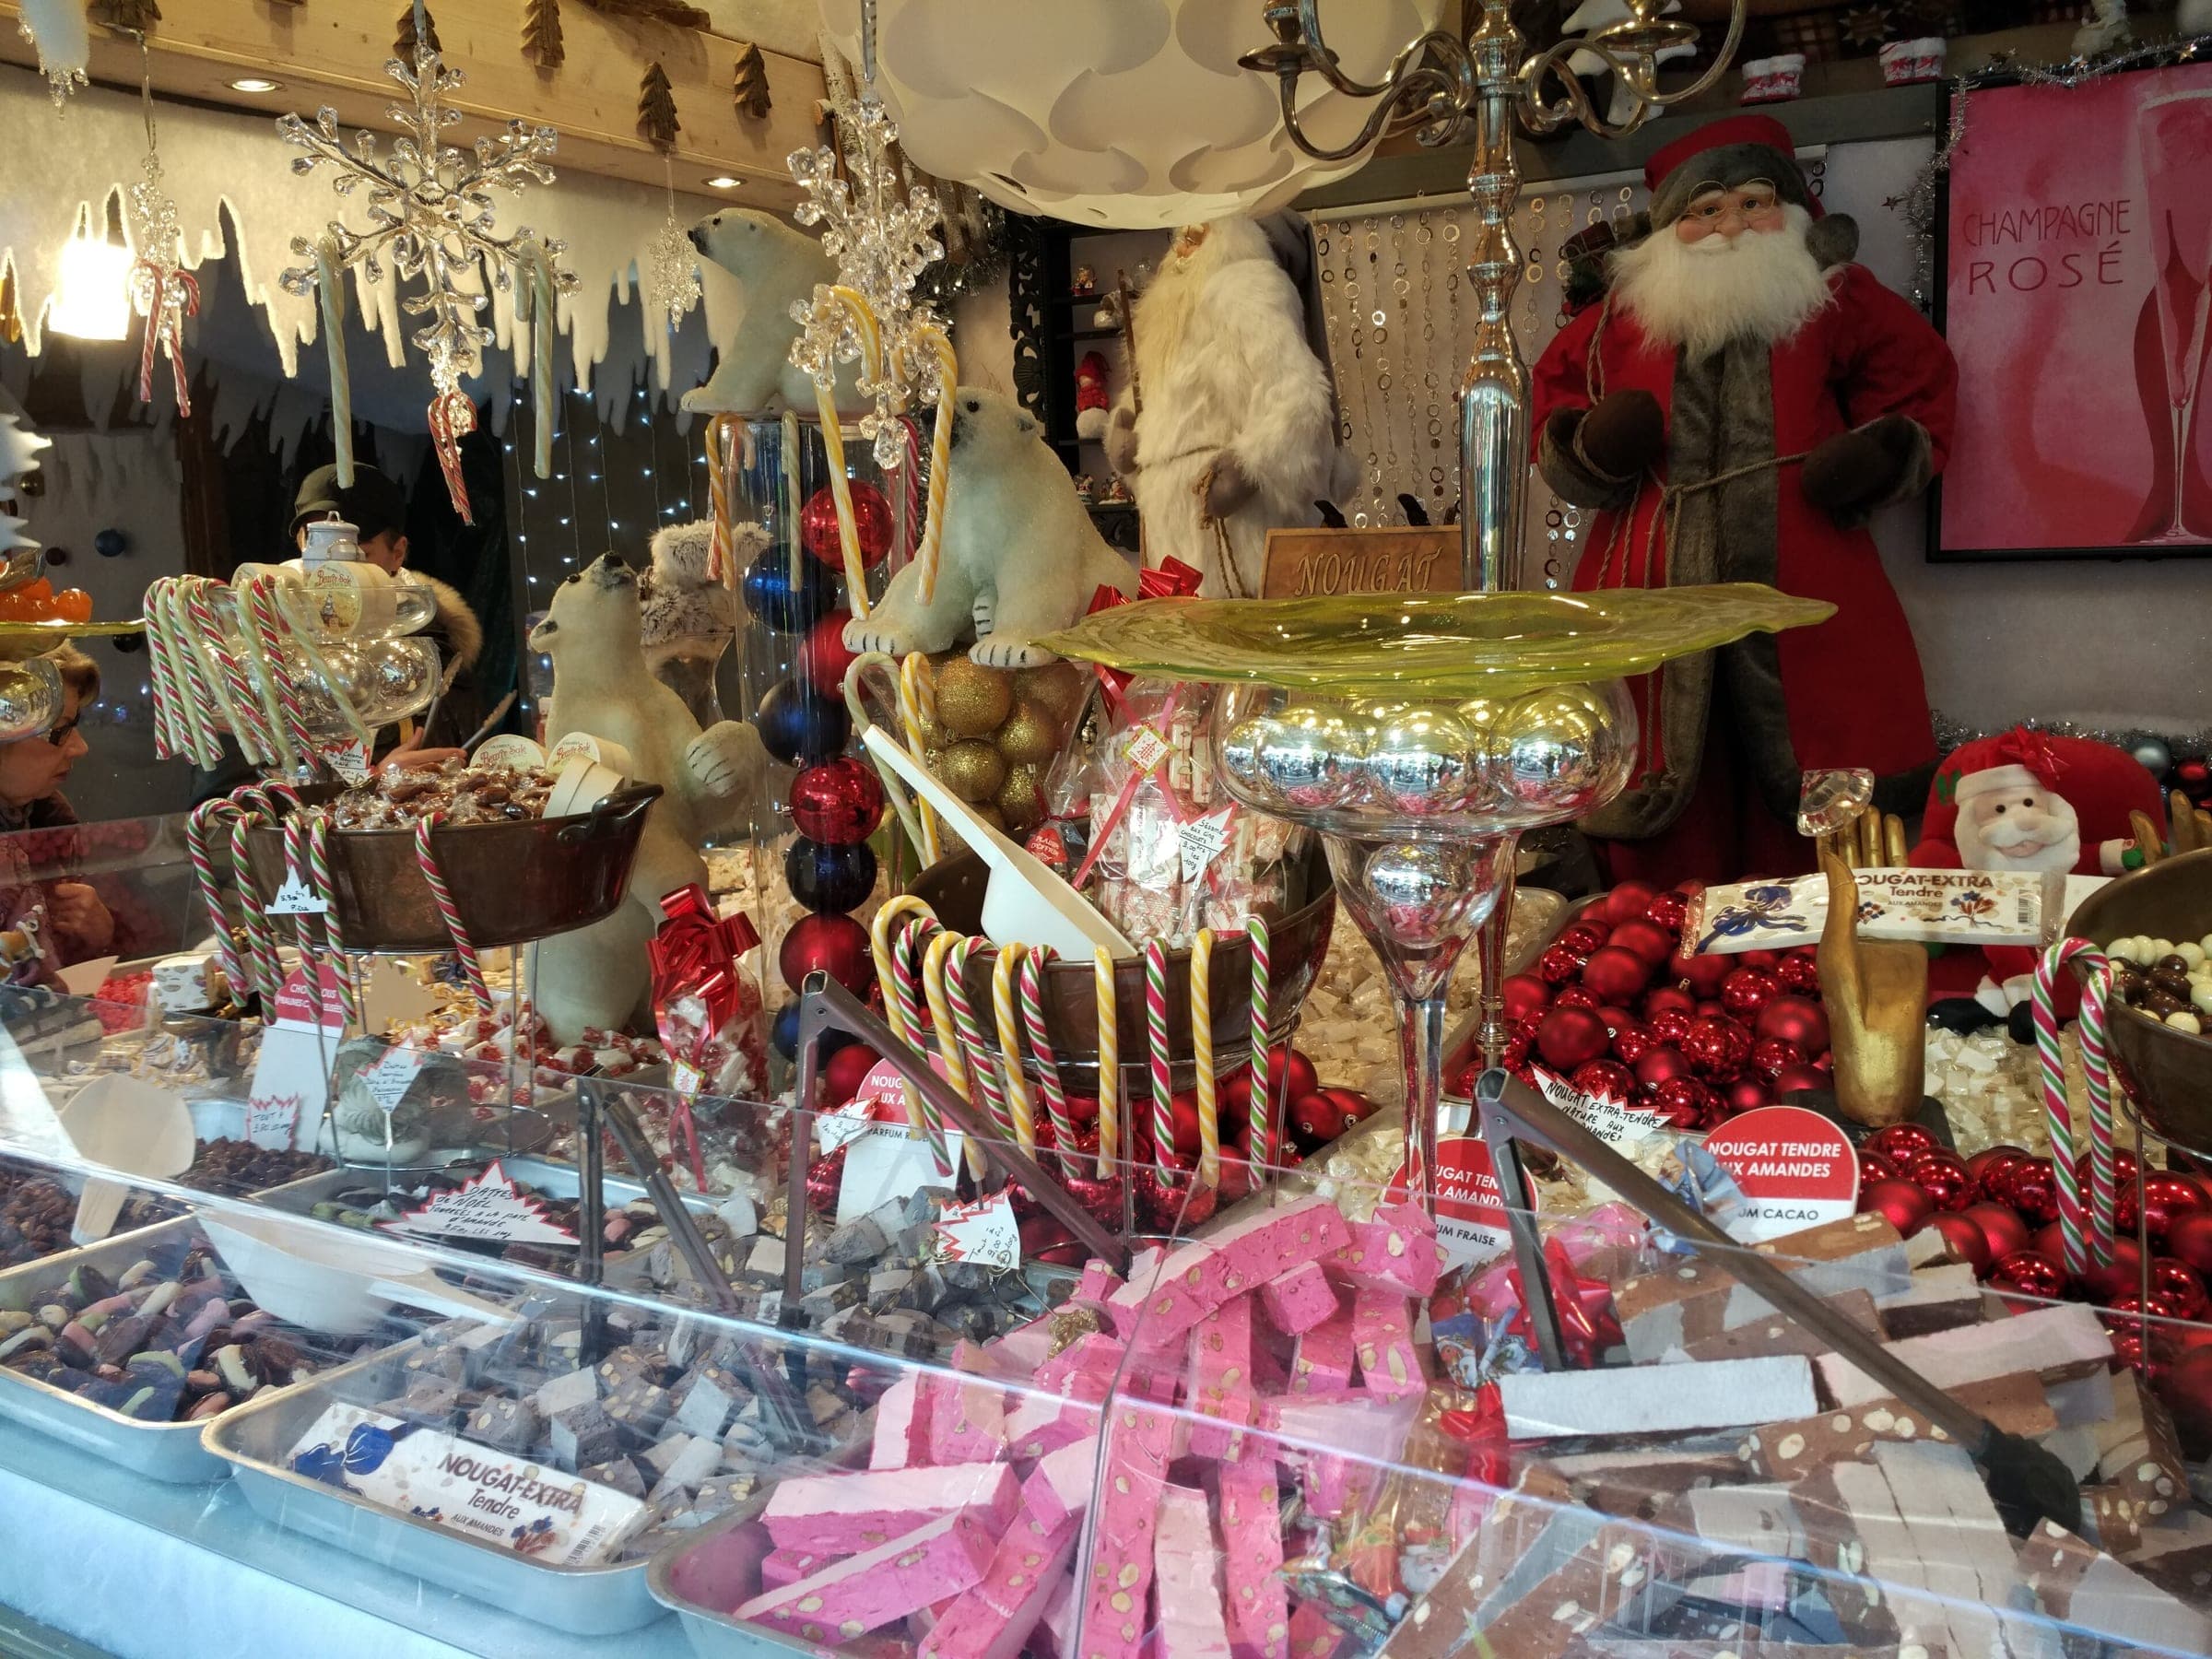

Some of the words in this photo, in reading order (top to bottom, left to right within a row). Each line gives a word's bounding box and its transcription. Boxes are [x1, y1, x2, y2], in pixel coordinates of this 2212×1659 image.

[1963, 199, 2131, 247] CHAMPAGNE
[1969, 241, 2124, 295] ROSÉ
[1294, 546, 1443, 596] NOUGAT
[1889, 886, 1944, 898] Tendre
[871, 1075, 903, 1089] NOUG
[880, 1092, 896, 1104] UX
[1546, 1082, 1590, 1107] NOUGAT
[1708, 1142, 1778, 1157] NOUGAT
[1782, 1143, 1842, 1158] TENDRE
[1747, 1161, 1831, 1178] AMANDES
[1476, 1174, 1499, 1190] TEN
[1443, 1185, 1504, 1208] AMAND
[1763, 1208, 1819, 1220] CACAO
[1456, 1230, 1496, 1246] FRAISE
[437, 1453, 584, 1515] NOUGAT-EXTRA
[467, 1488, 521, 1520] Tendre
[450, 1513, 467, 1525] AUX
[465, 1518, 505, 1537] AMANDES
